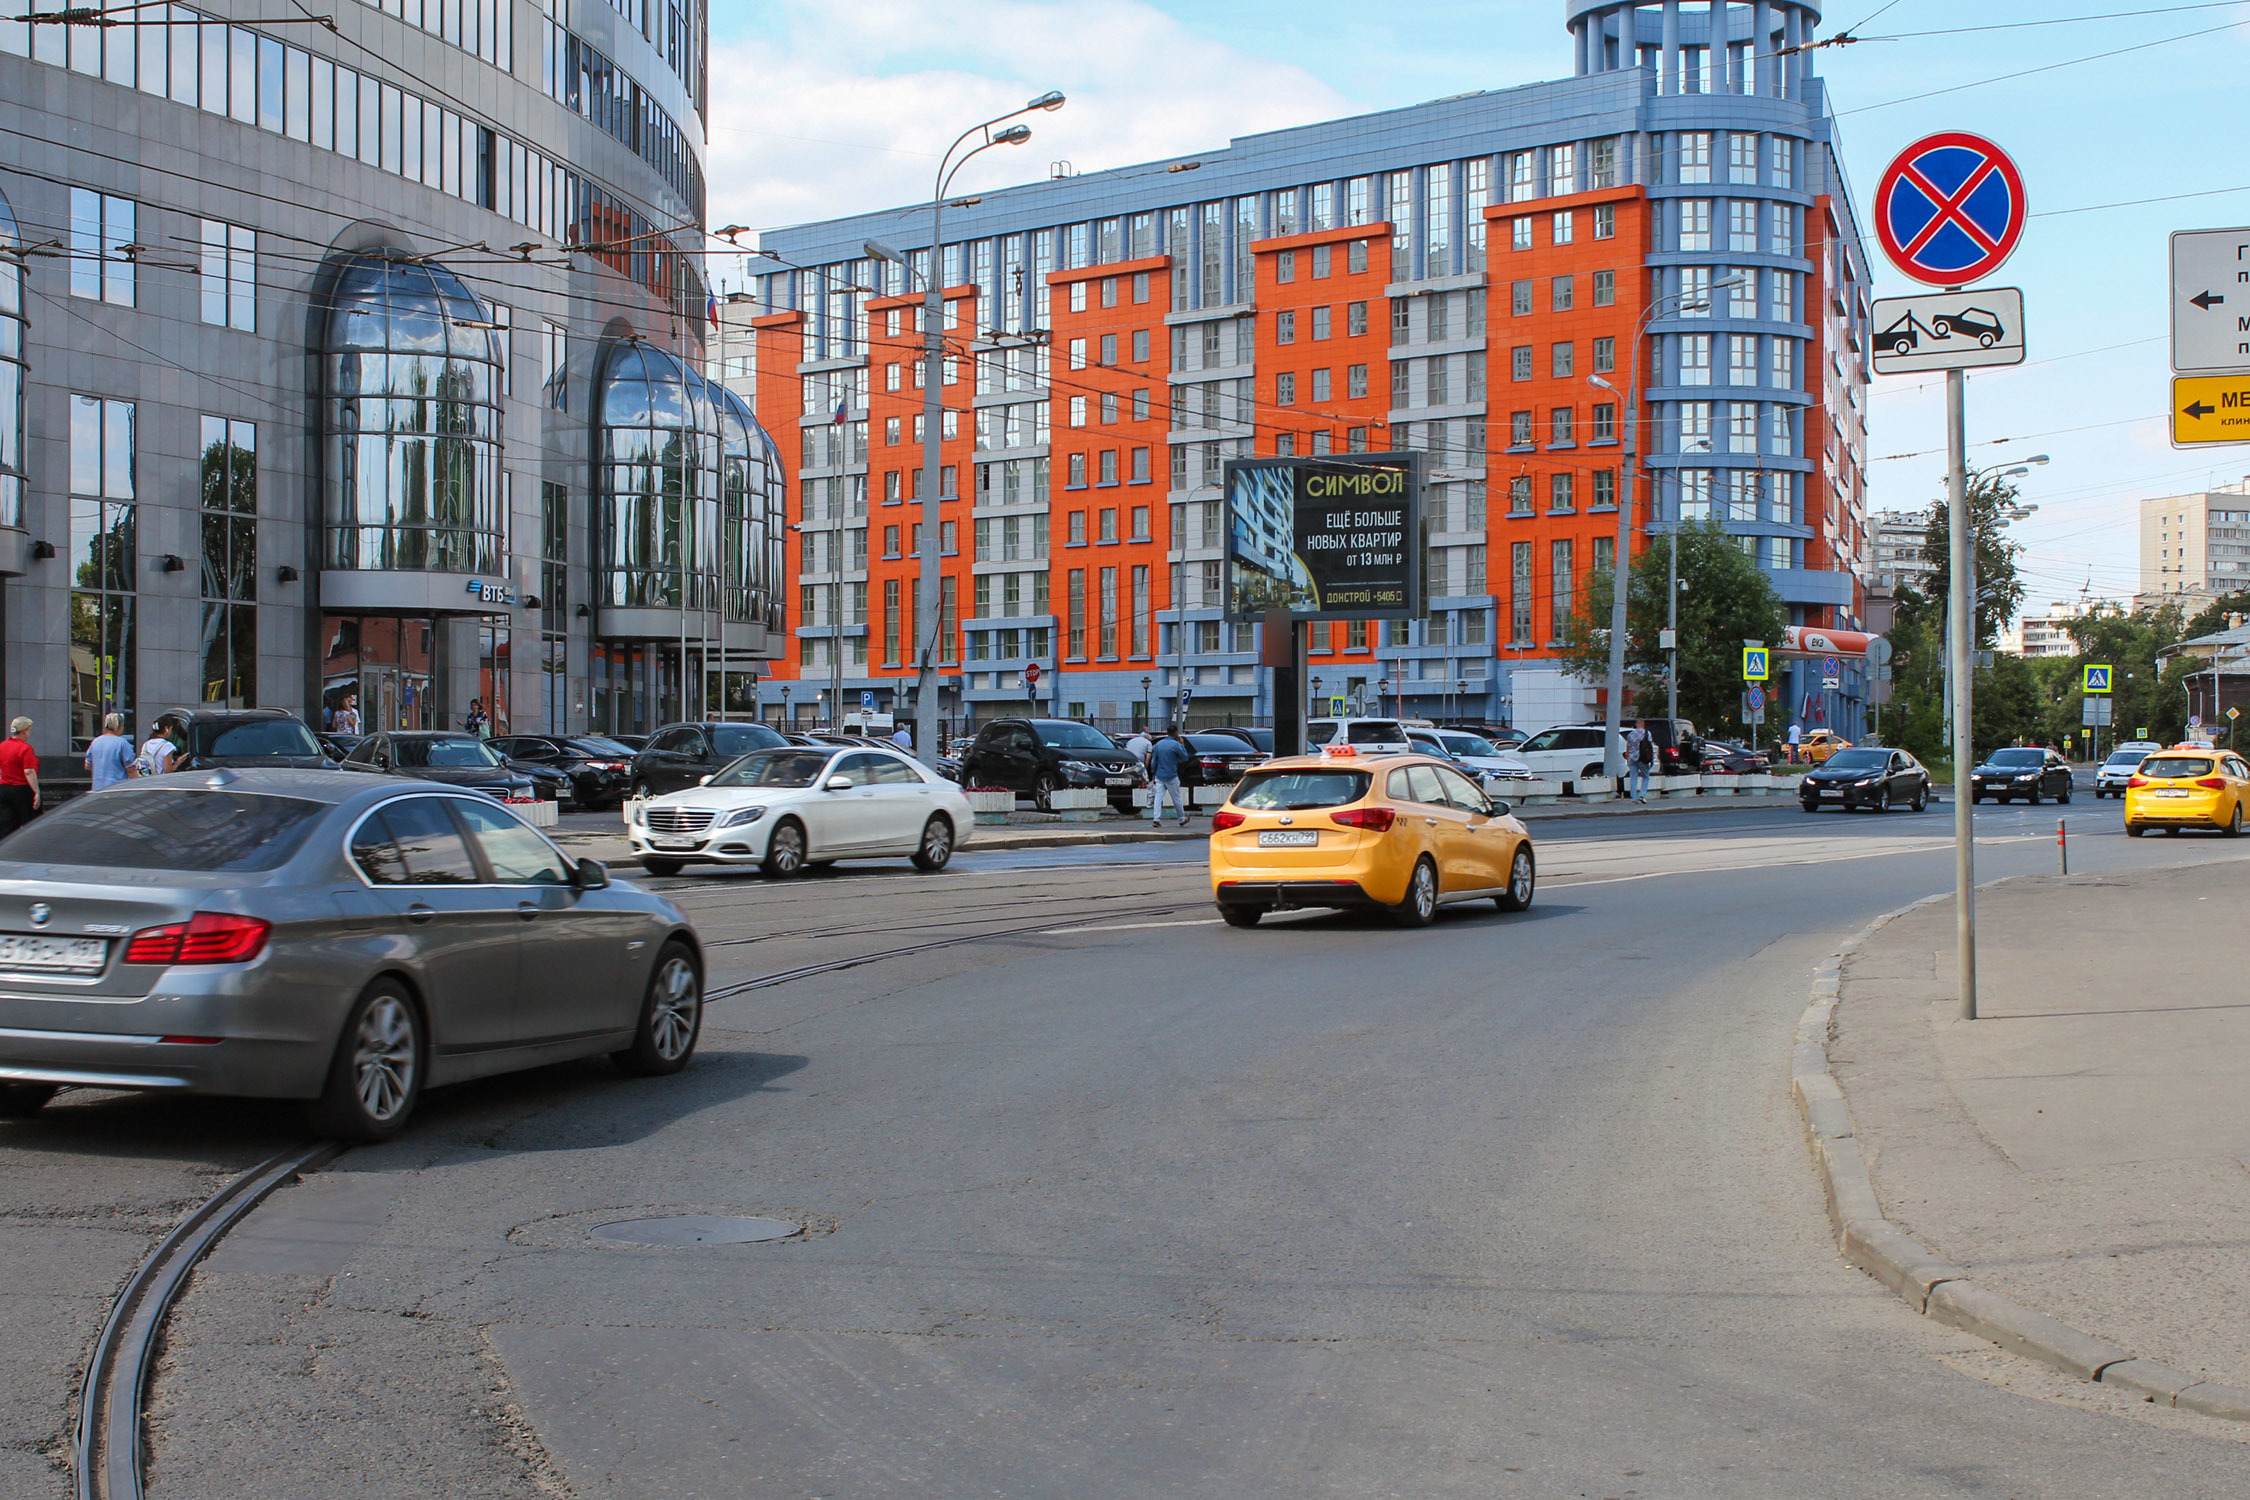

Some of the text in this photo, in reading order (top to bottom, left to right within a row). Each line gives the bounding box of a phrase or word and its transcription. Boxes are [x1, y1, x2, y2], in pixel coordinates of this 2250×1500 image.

[2221, 391, 2250, 408] МЕ
[1306, 472, 1403, 497] СИМВОЛ
[1326, 510, 1402, 529] ЕЩЁ БОЛЬШЕ
[1307, 532, 1402, 550] НОВЫХ КВАРТИР
[1360, 552, 1372, 566] 13
[483, 585, 504, 603] ВТБ
[1326, 589, 1371, 604] ДОНСТРОЙ
[1026, 668, 1040, 678] STOP
